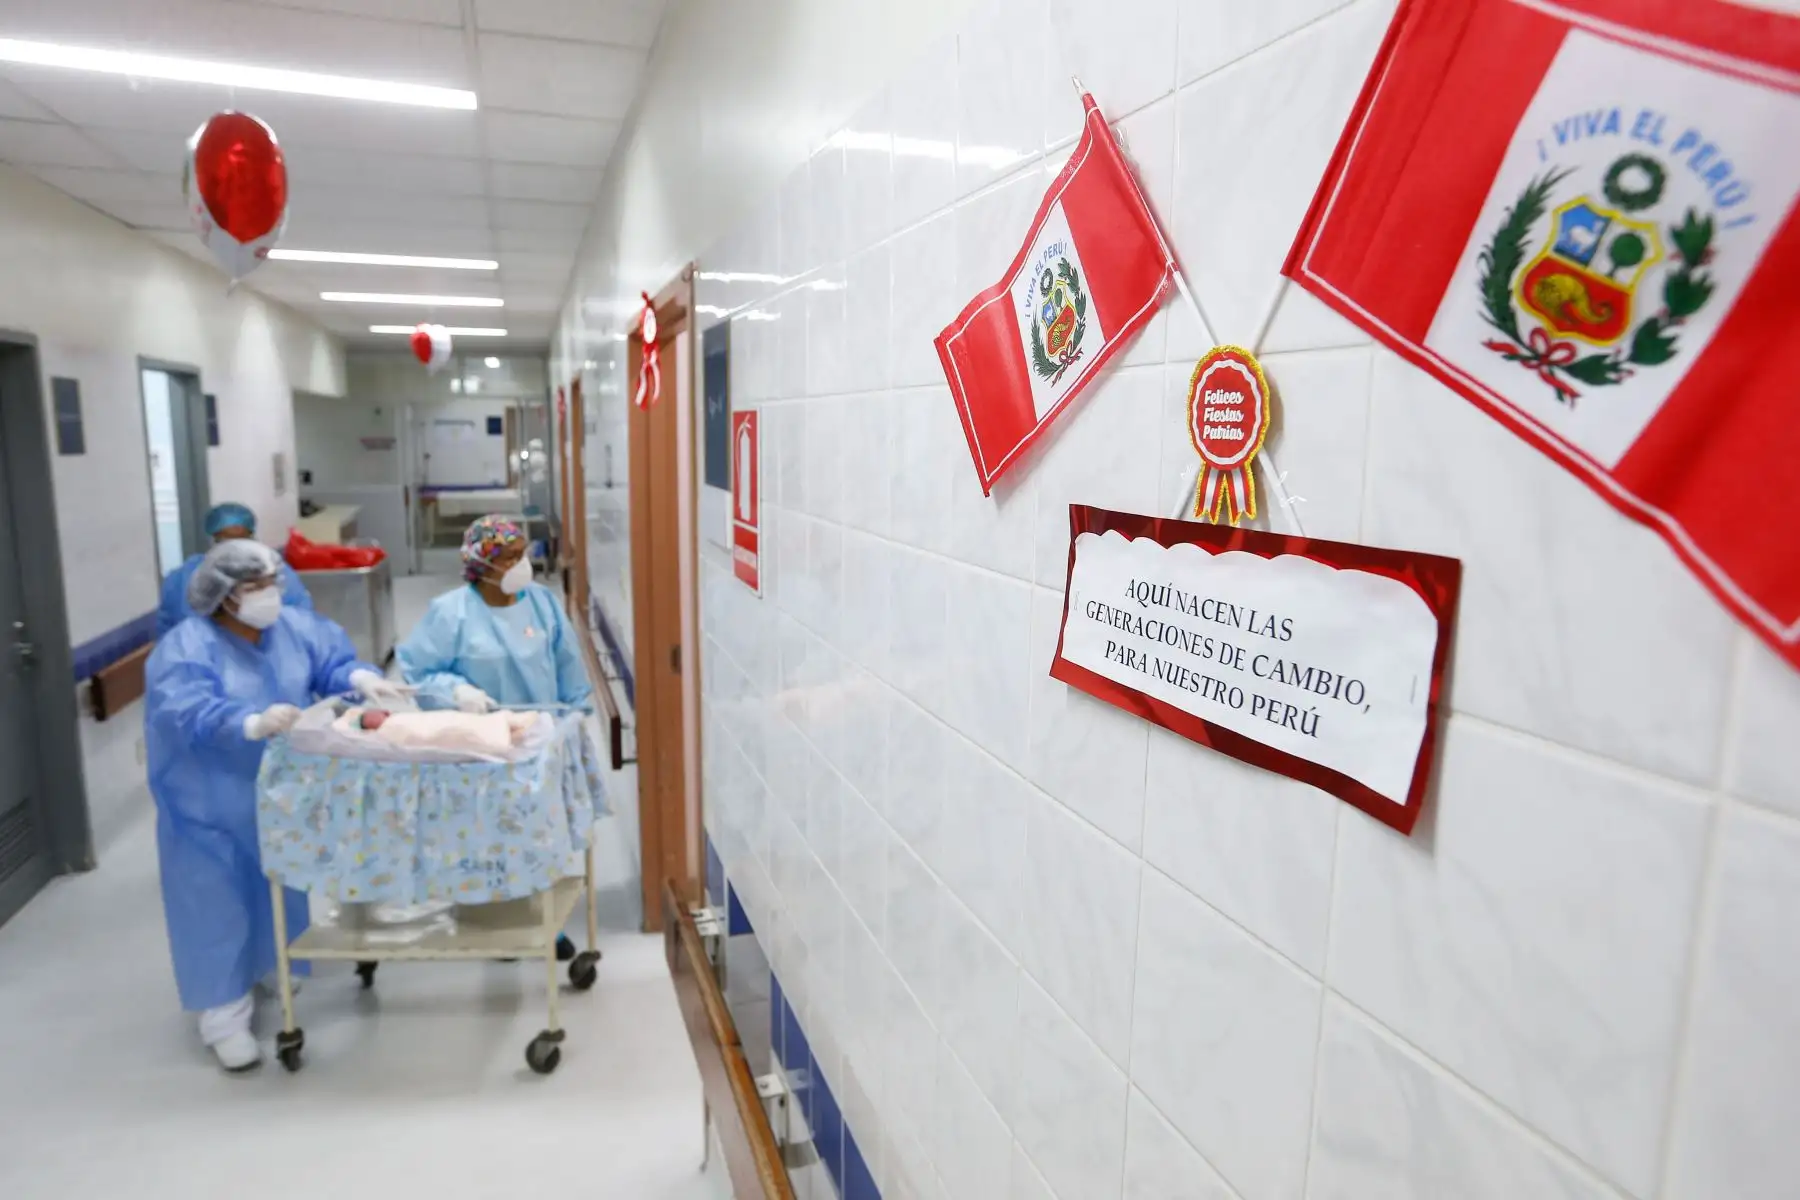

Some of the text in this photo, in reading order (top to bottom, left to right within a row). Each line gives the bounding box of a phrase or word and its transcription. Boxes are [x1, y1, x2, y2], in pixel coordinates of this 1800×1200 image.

[1629, 110, 1667, 146] EL
[1035, 260, 1044, 276] EL
[1204, 389, 1245, 405] Felices
[1203, 407, 1245, 423] Fiestas
[1202, 424, 1245, 441] Patrias
[1124, 578, 1294, 642] AQUÍ NACEN LAS
[1086, 600, 1371, 713] GENERACIONES DE CAMBIO,
[1104, 640, 1321, 738] PARA NUESTRO PERÚ
